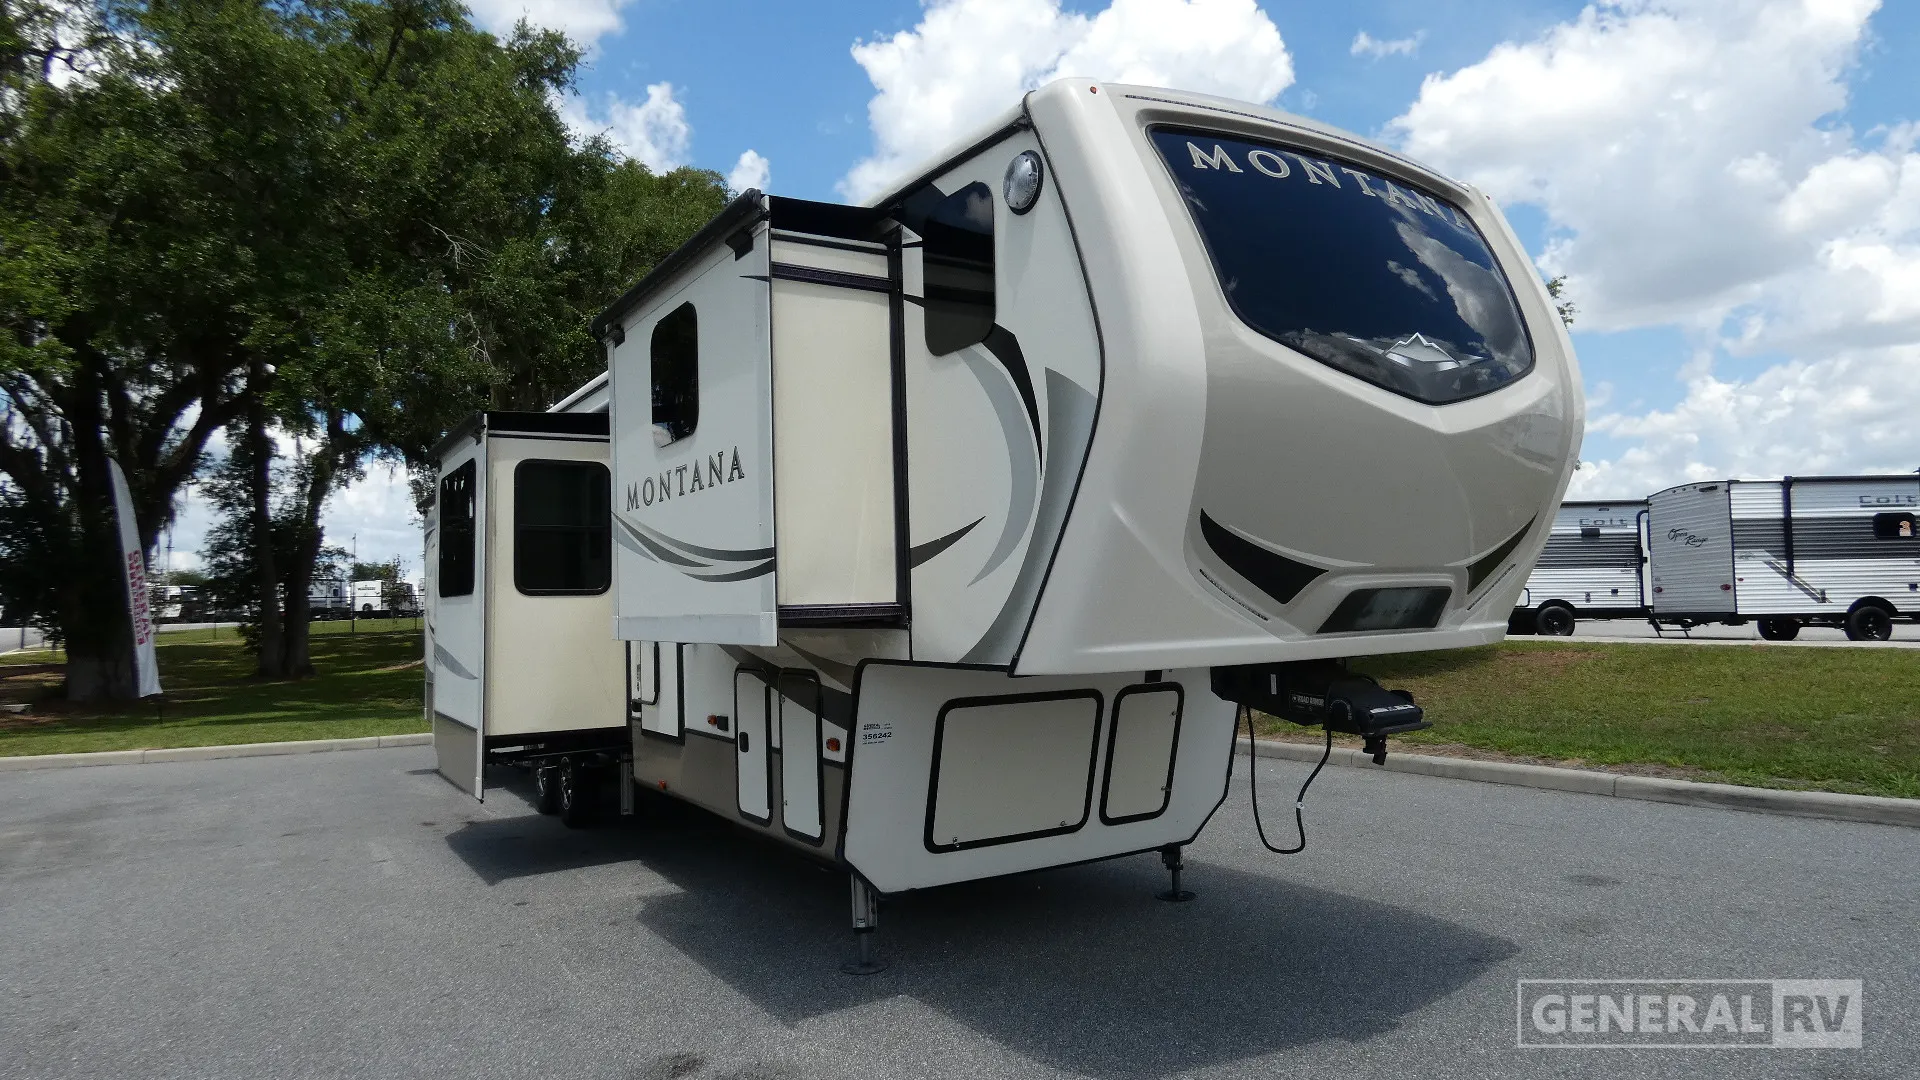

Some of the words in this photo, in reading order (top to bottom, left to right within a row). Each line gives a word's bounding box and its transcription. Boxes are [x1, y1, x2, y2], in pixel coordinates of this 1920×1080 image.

[626, 445, 745, 512] MONTANA
[1859, 494, 1916, 503] Colt
[1579, 518, 1628, 526] Colt
[862, 731, 892, 740] 356242
